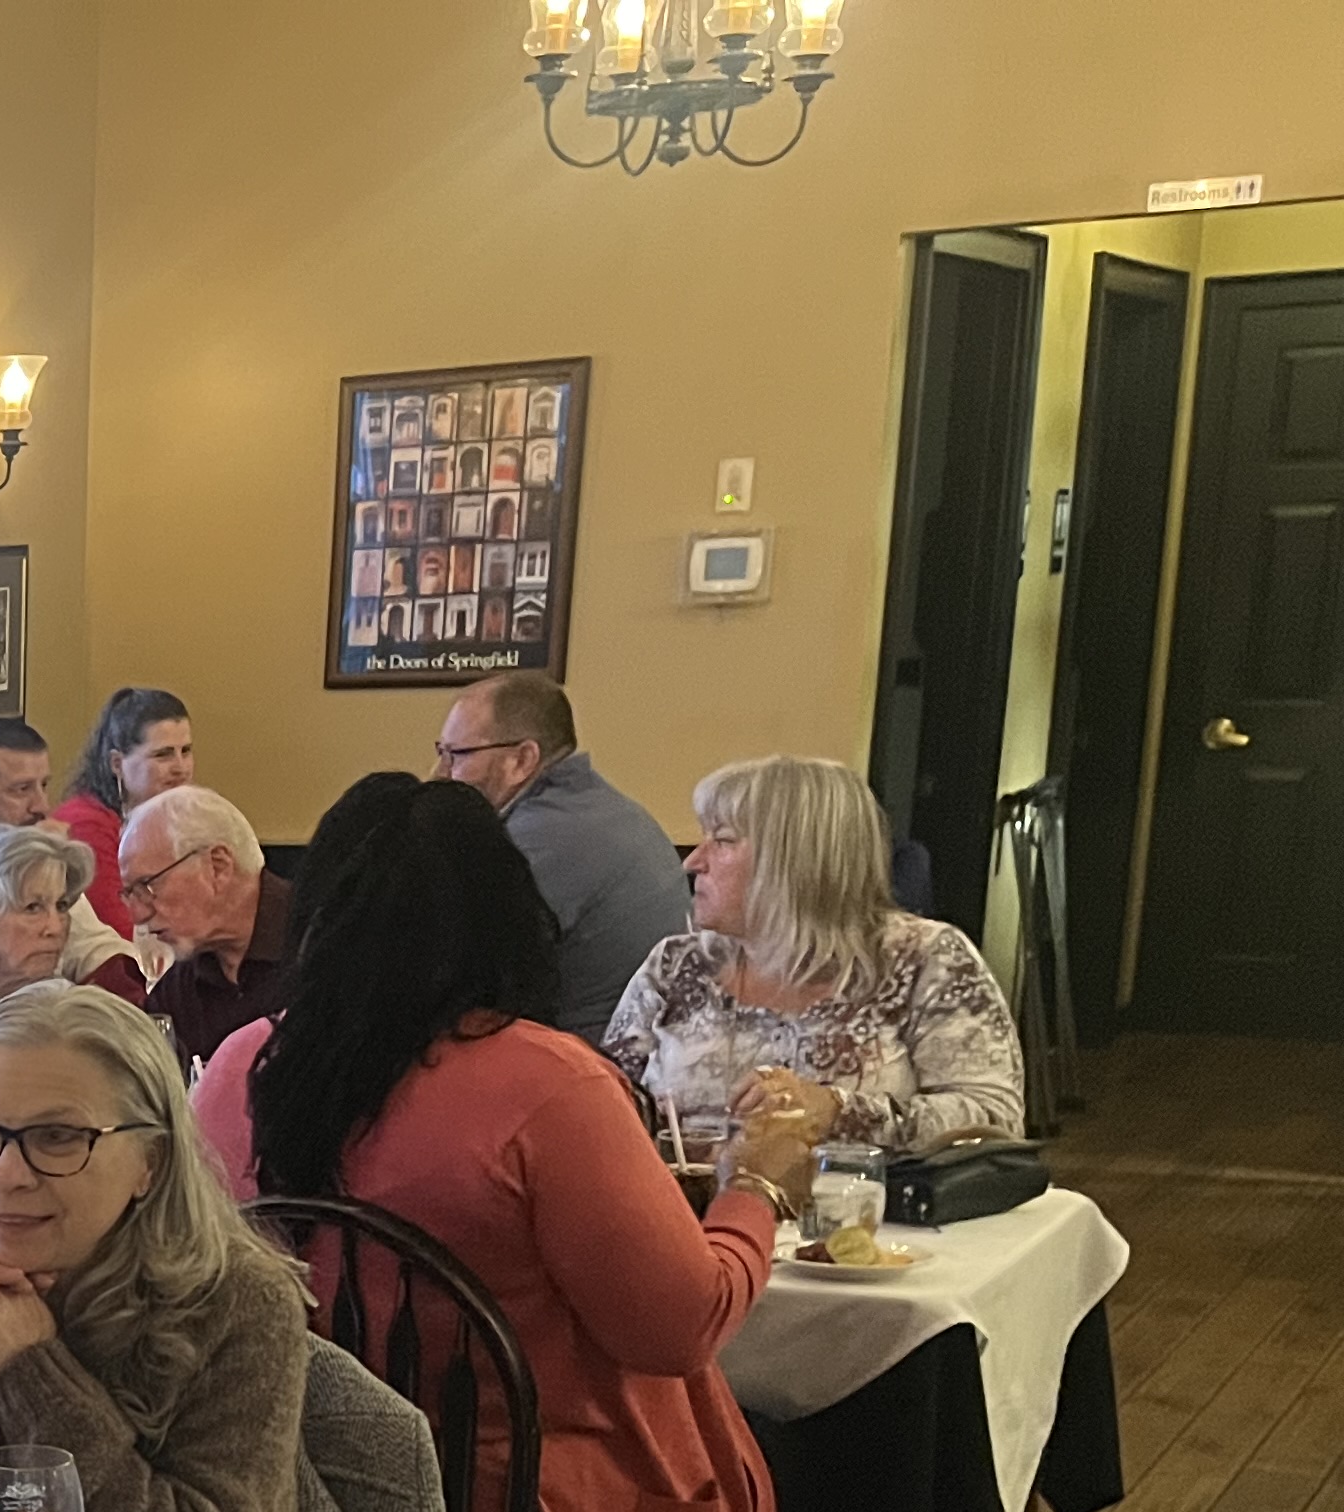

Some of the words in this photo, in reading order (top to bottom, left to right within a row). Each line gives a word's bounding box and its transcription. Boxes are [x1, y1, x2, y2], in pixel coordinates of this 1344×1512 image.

[1151, 187, 1230, 206] Restrooms
[366, 653, 387, 670] the
[389, 653, 429, 670] Doors
[430, 652, 447, 670] of
[447, 650, 520, 672] Springfield
